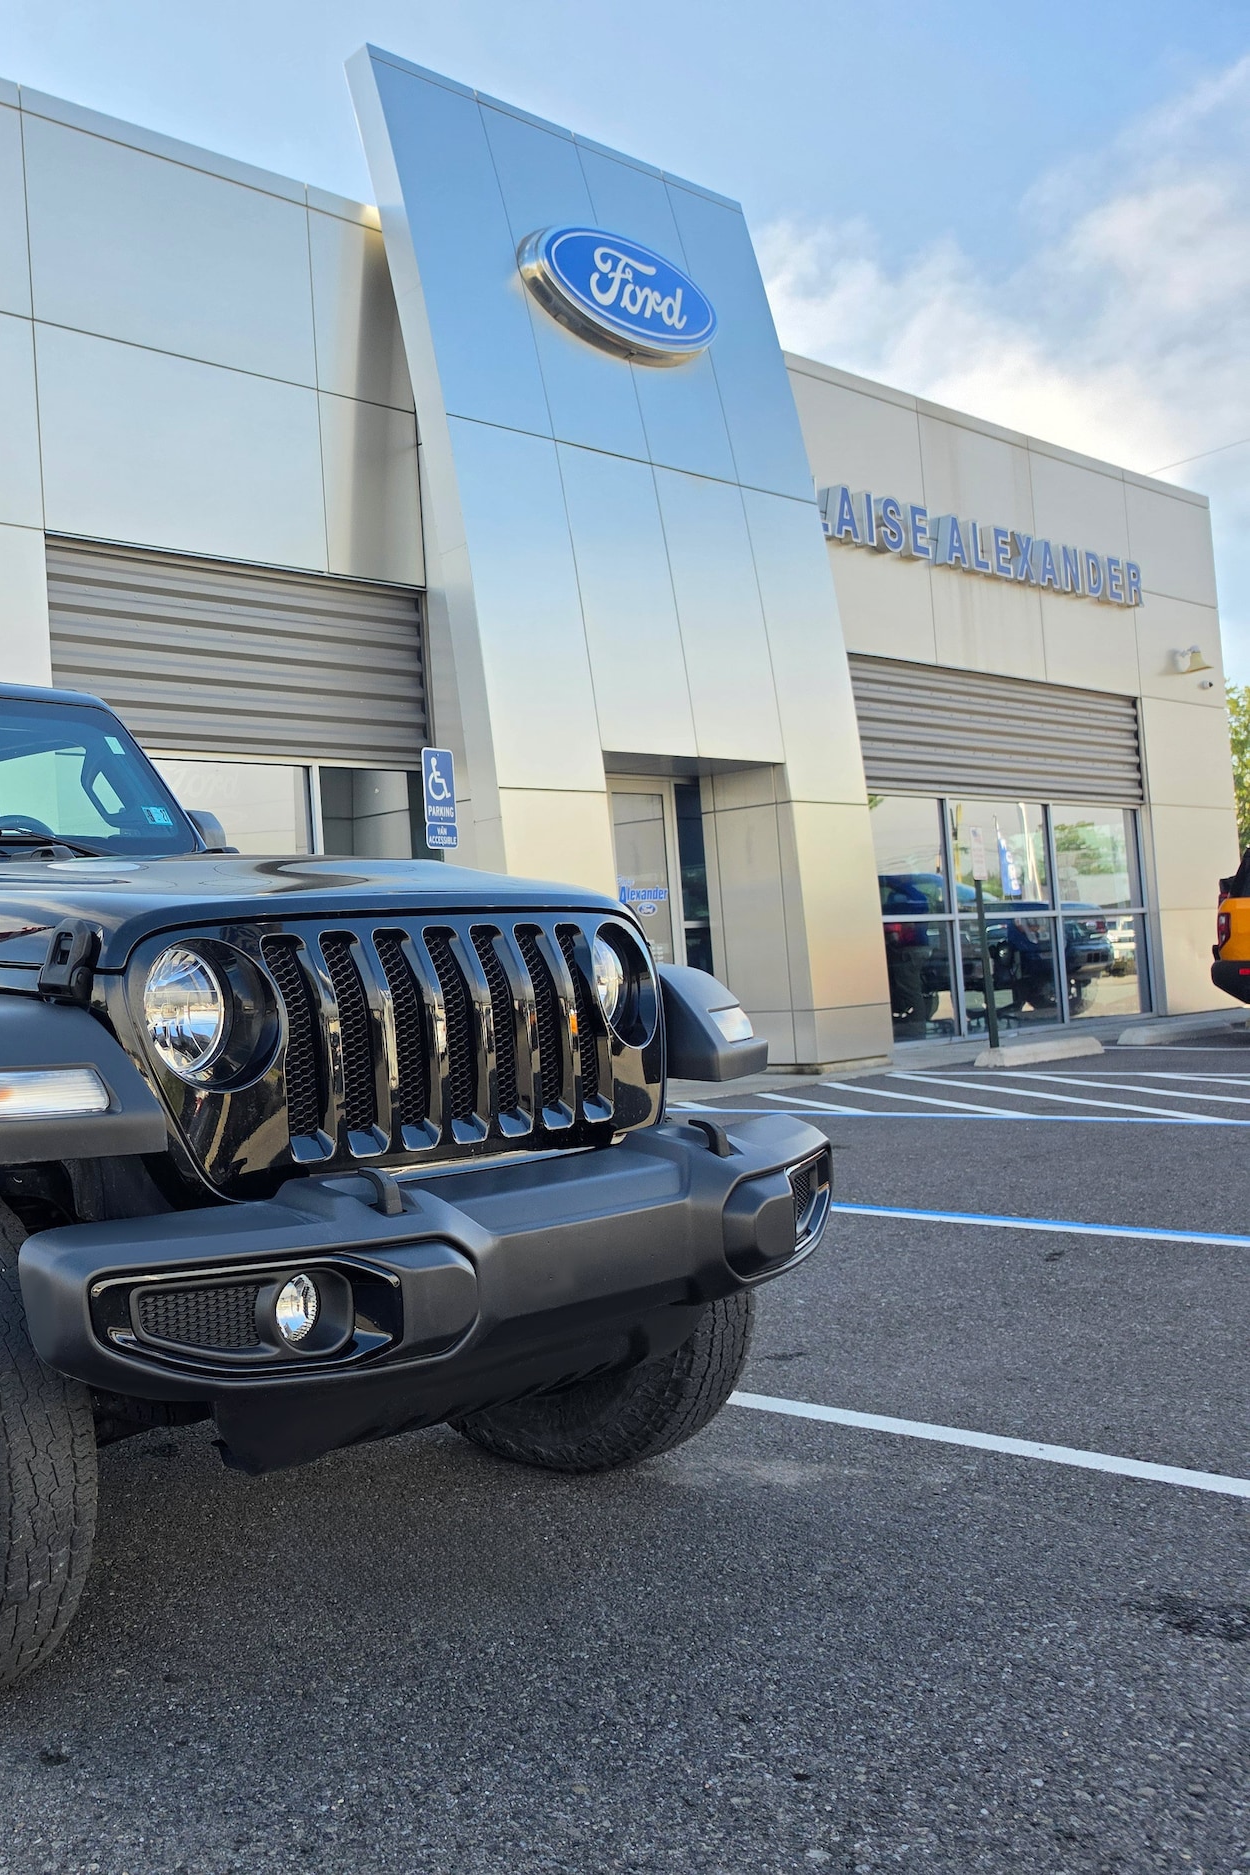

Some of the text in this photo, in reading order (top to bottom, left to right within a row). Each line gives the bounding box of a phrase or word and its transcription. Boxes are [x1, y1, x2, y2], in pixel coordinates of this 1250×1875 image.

[589, 246, 688, 330] Ford
[945, 513, 1144, 607] ALEXANDER
[428, 805, 455, 818] PARKING
[436, 827, 448, 835] VAN
[619, 885, 668, 904] Alexander
